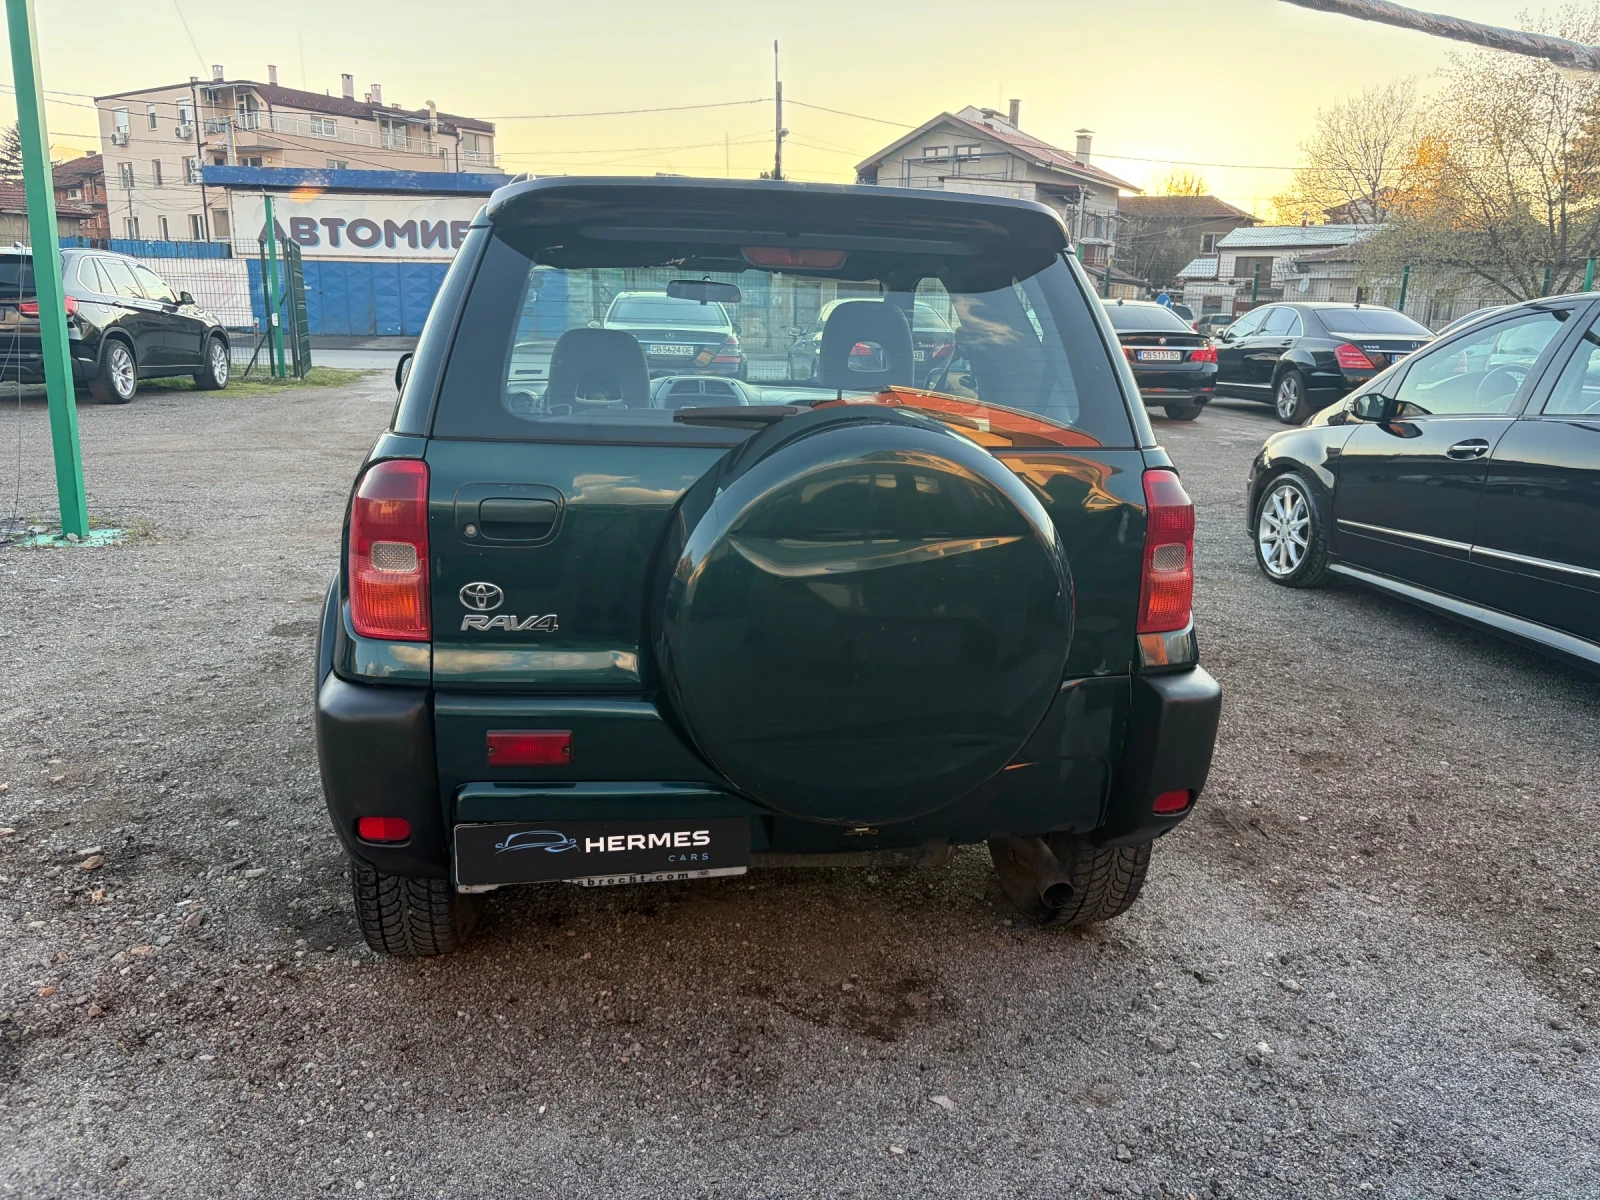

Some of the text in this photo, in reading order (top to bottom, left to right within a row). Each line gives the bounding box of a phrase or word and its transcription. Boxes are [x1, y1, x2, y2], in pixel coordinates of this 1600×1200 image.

[460, 614, 559, 632] RAV4
[585, 830, 711, 853] HERMES
[668, 852, 709, 862] CARS
